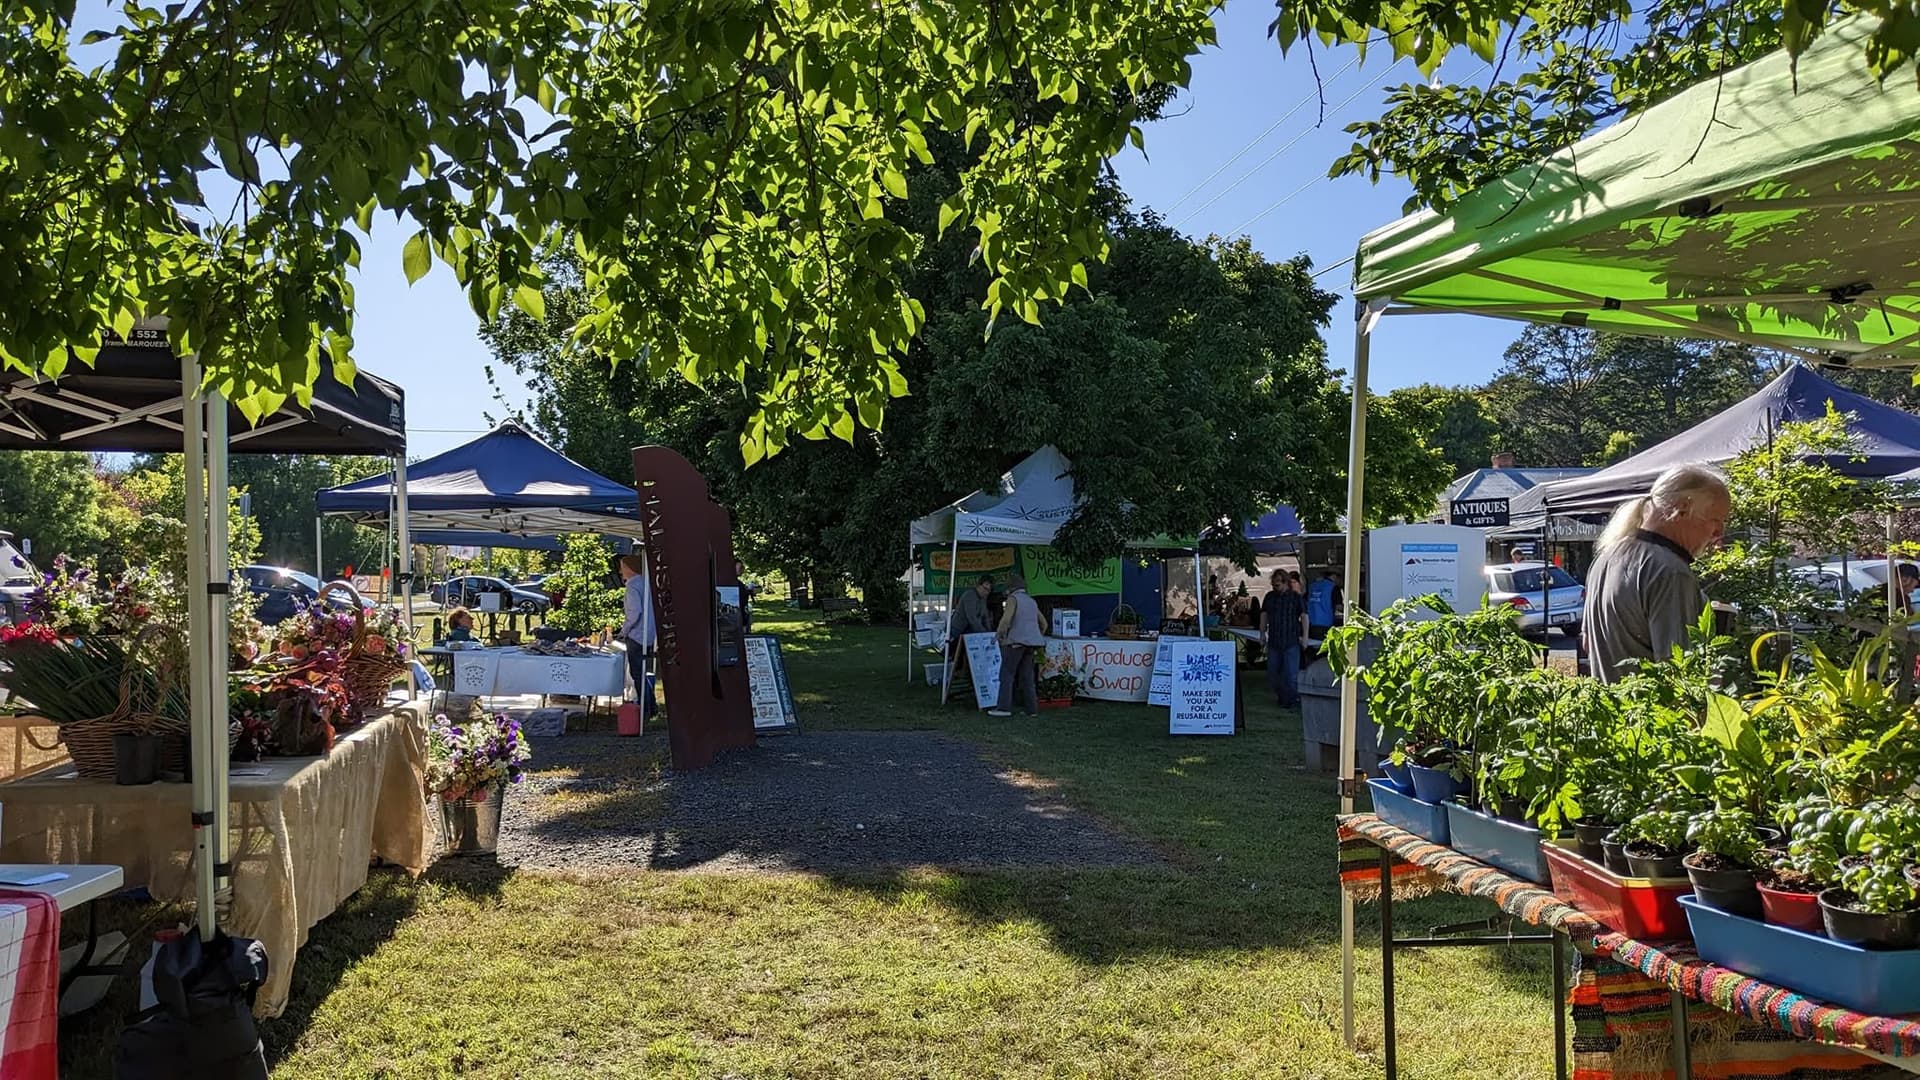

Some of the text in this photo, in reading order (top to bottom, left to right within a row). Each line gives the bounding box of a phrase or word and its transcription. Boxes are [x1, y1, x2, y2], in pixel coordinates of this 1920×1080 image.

[136, 330, 158, 338] 552
[1452, 500, 1508, 516] ANTIQUES
[1465, 516, 1496, 525] & GIFTS
[1082, 643, 1153, 667] Produce
[1186, 654, 1220, 665] WASH
[1182, 670, 1223, 681] WASTE
[1088, 668, 1143, 695] Swap
[1176, 712, 1228, 720] REUSABLE CUP
